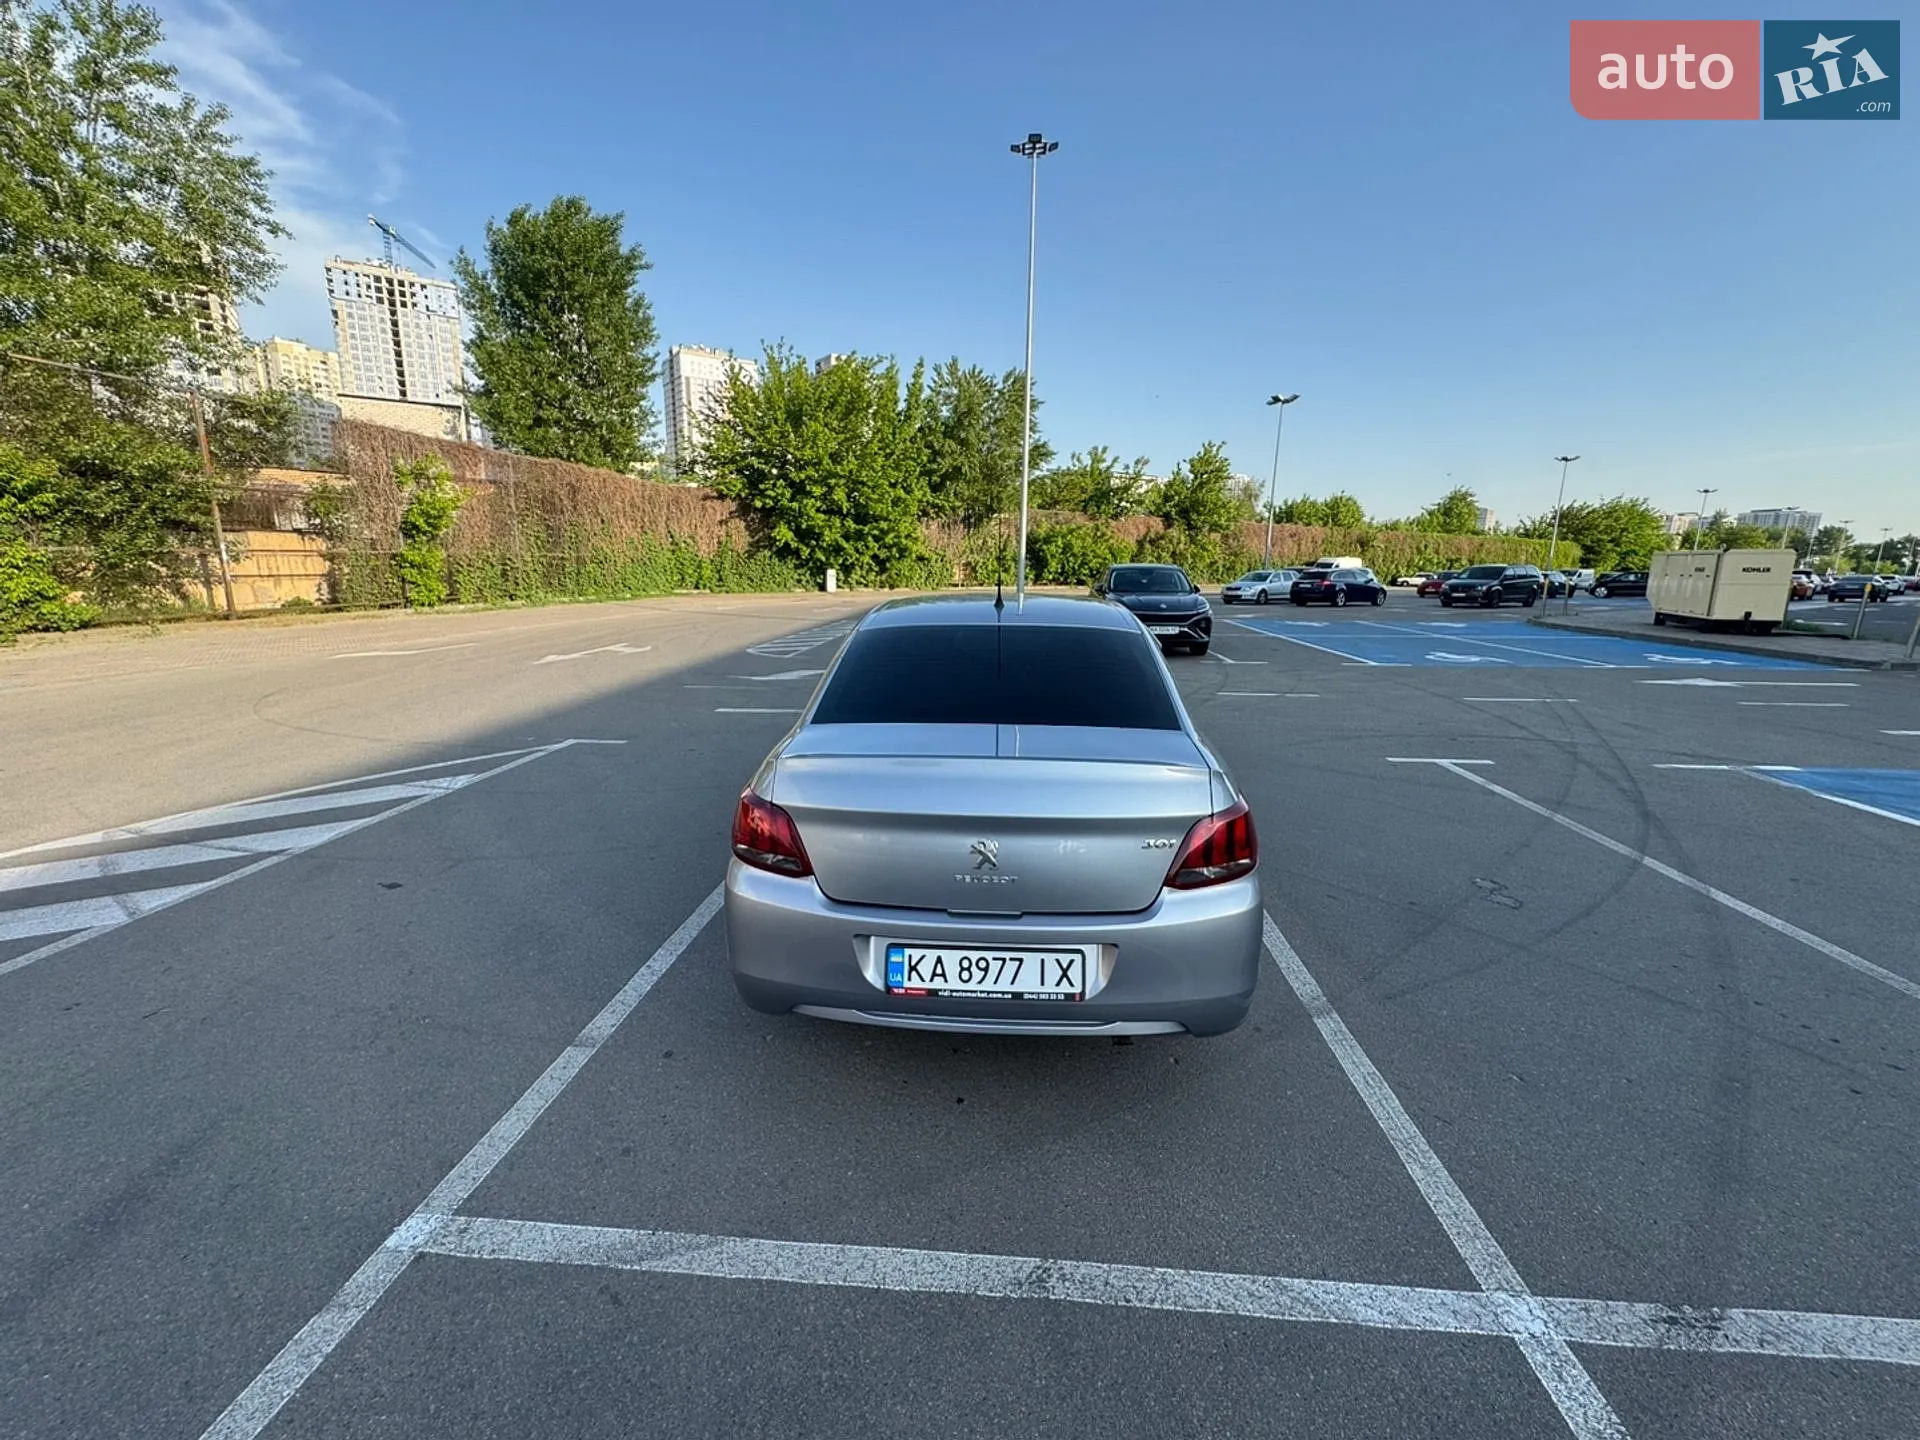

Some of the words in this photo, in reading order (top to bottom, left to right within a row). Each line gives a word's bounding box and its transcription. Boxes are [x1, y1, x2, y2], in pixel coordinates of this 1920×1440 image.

[954, 874, 1019, 884] PEUGEOT
[907, 954, 948, 983] KA
[958, 956, 1024, 985] 8977
[1040, 958, 1076, 988] IX
[889, 974, 902, 982] UA
